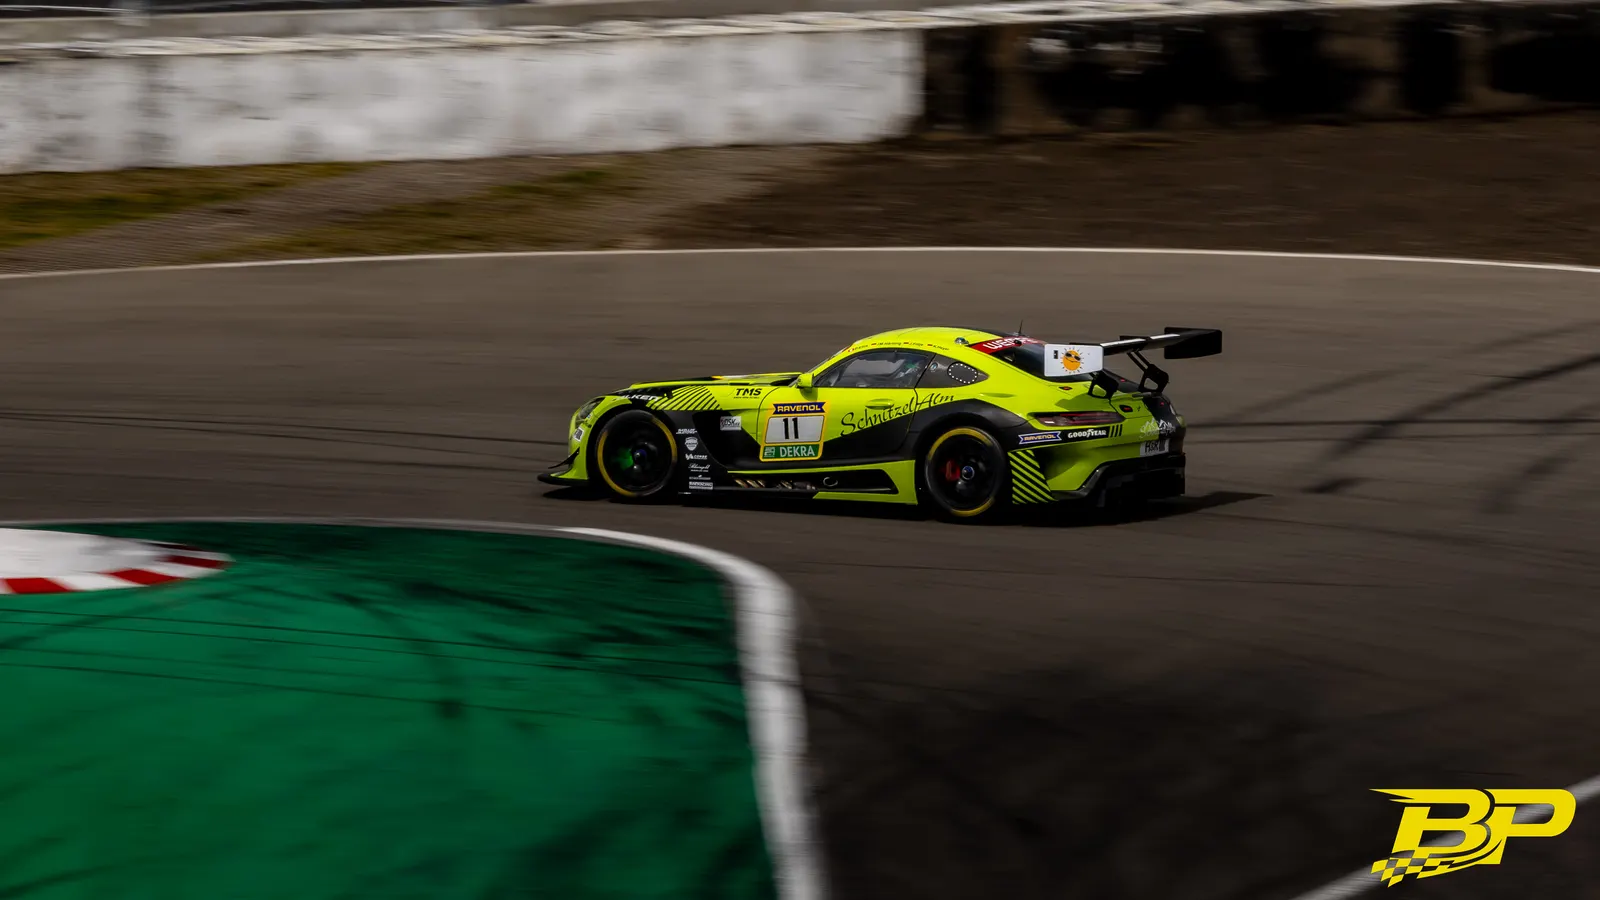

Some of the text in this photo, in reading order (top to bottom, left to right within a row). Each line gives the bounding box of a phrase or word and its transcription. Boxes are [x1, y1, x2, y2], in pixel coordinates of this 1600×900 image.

[736, 388, 762, 396] TMS
[777, 404, 821, 412] RAVENOL
[783, 417, 799, 440] 11
[1067, 429, 1107, 438] GOODYEAR
[780, 445, 815, 457] DEKRA
